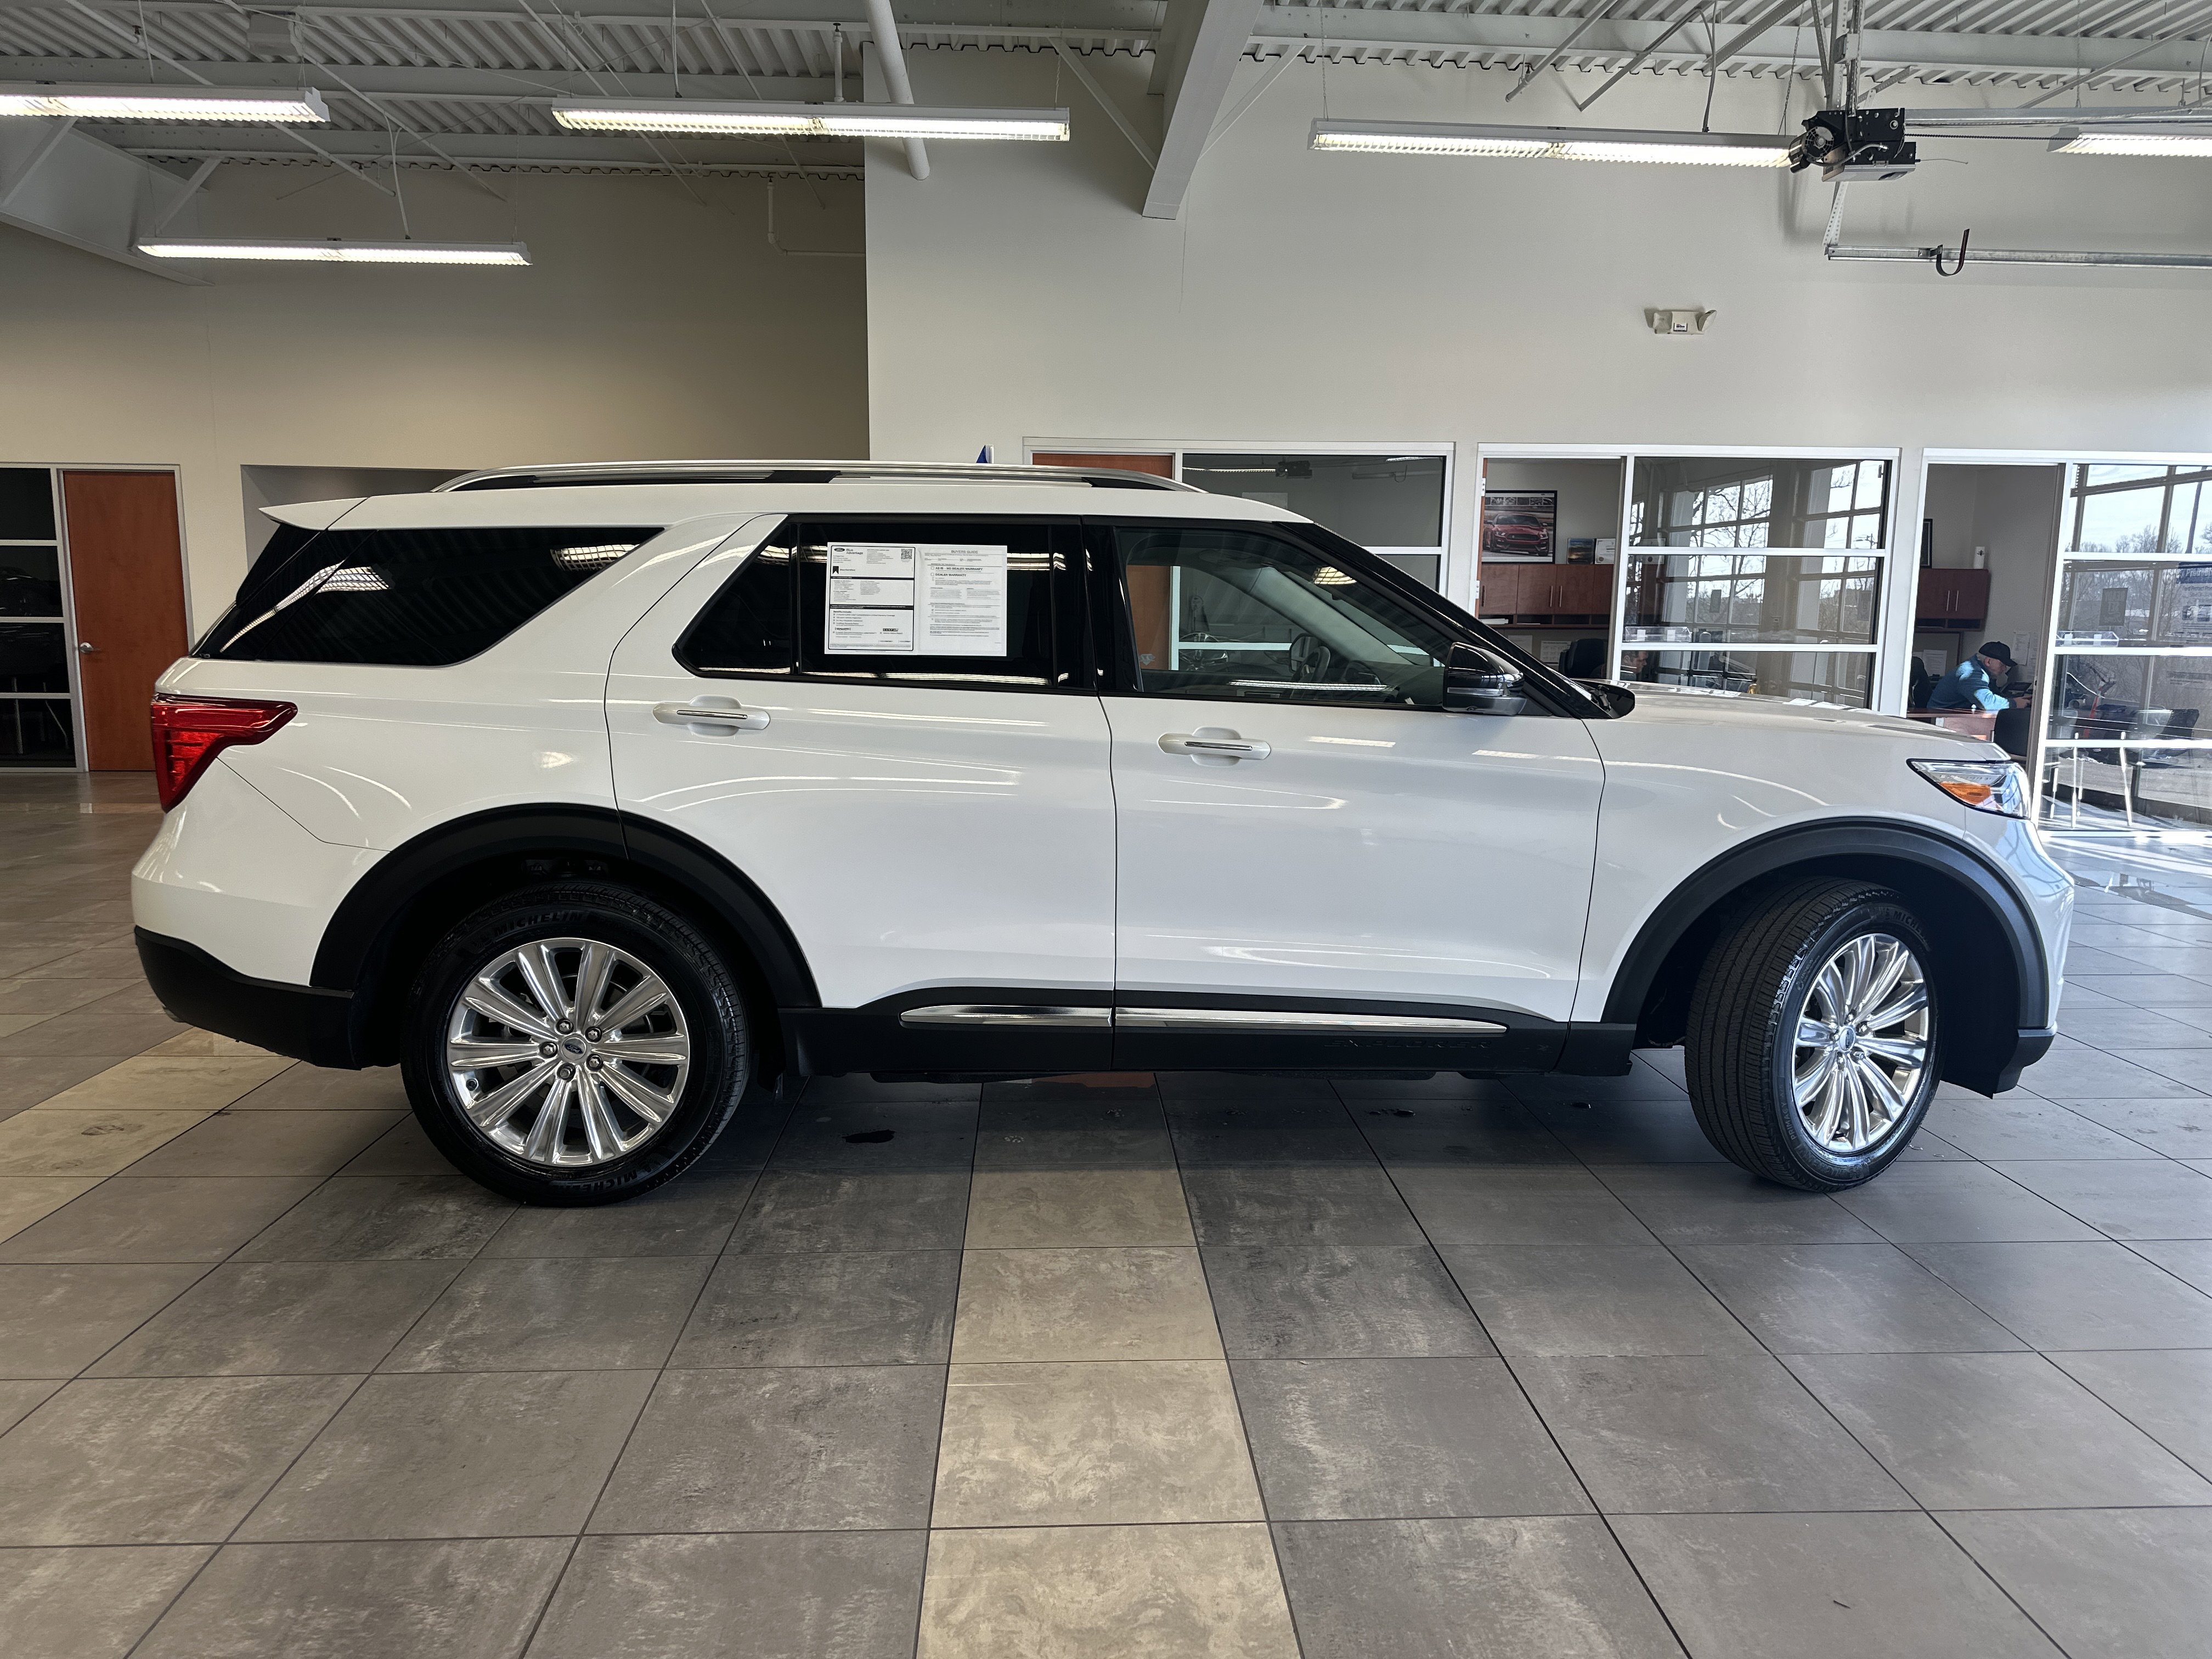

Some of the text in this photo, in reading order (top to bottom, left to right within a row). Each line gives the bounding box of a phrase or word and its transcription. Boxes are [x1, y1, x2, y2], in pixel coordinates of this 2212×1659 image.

[494, 911, 583, 934] MICHELIN
[1324, 1039, 1492, 1049] EXPLORER
[1781, 1102, 1797, 1141] PRIMACY
